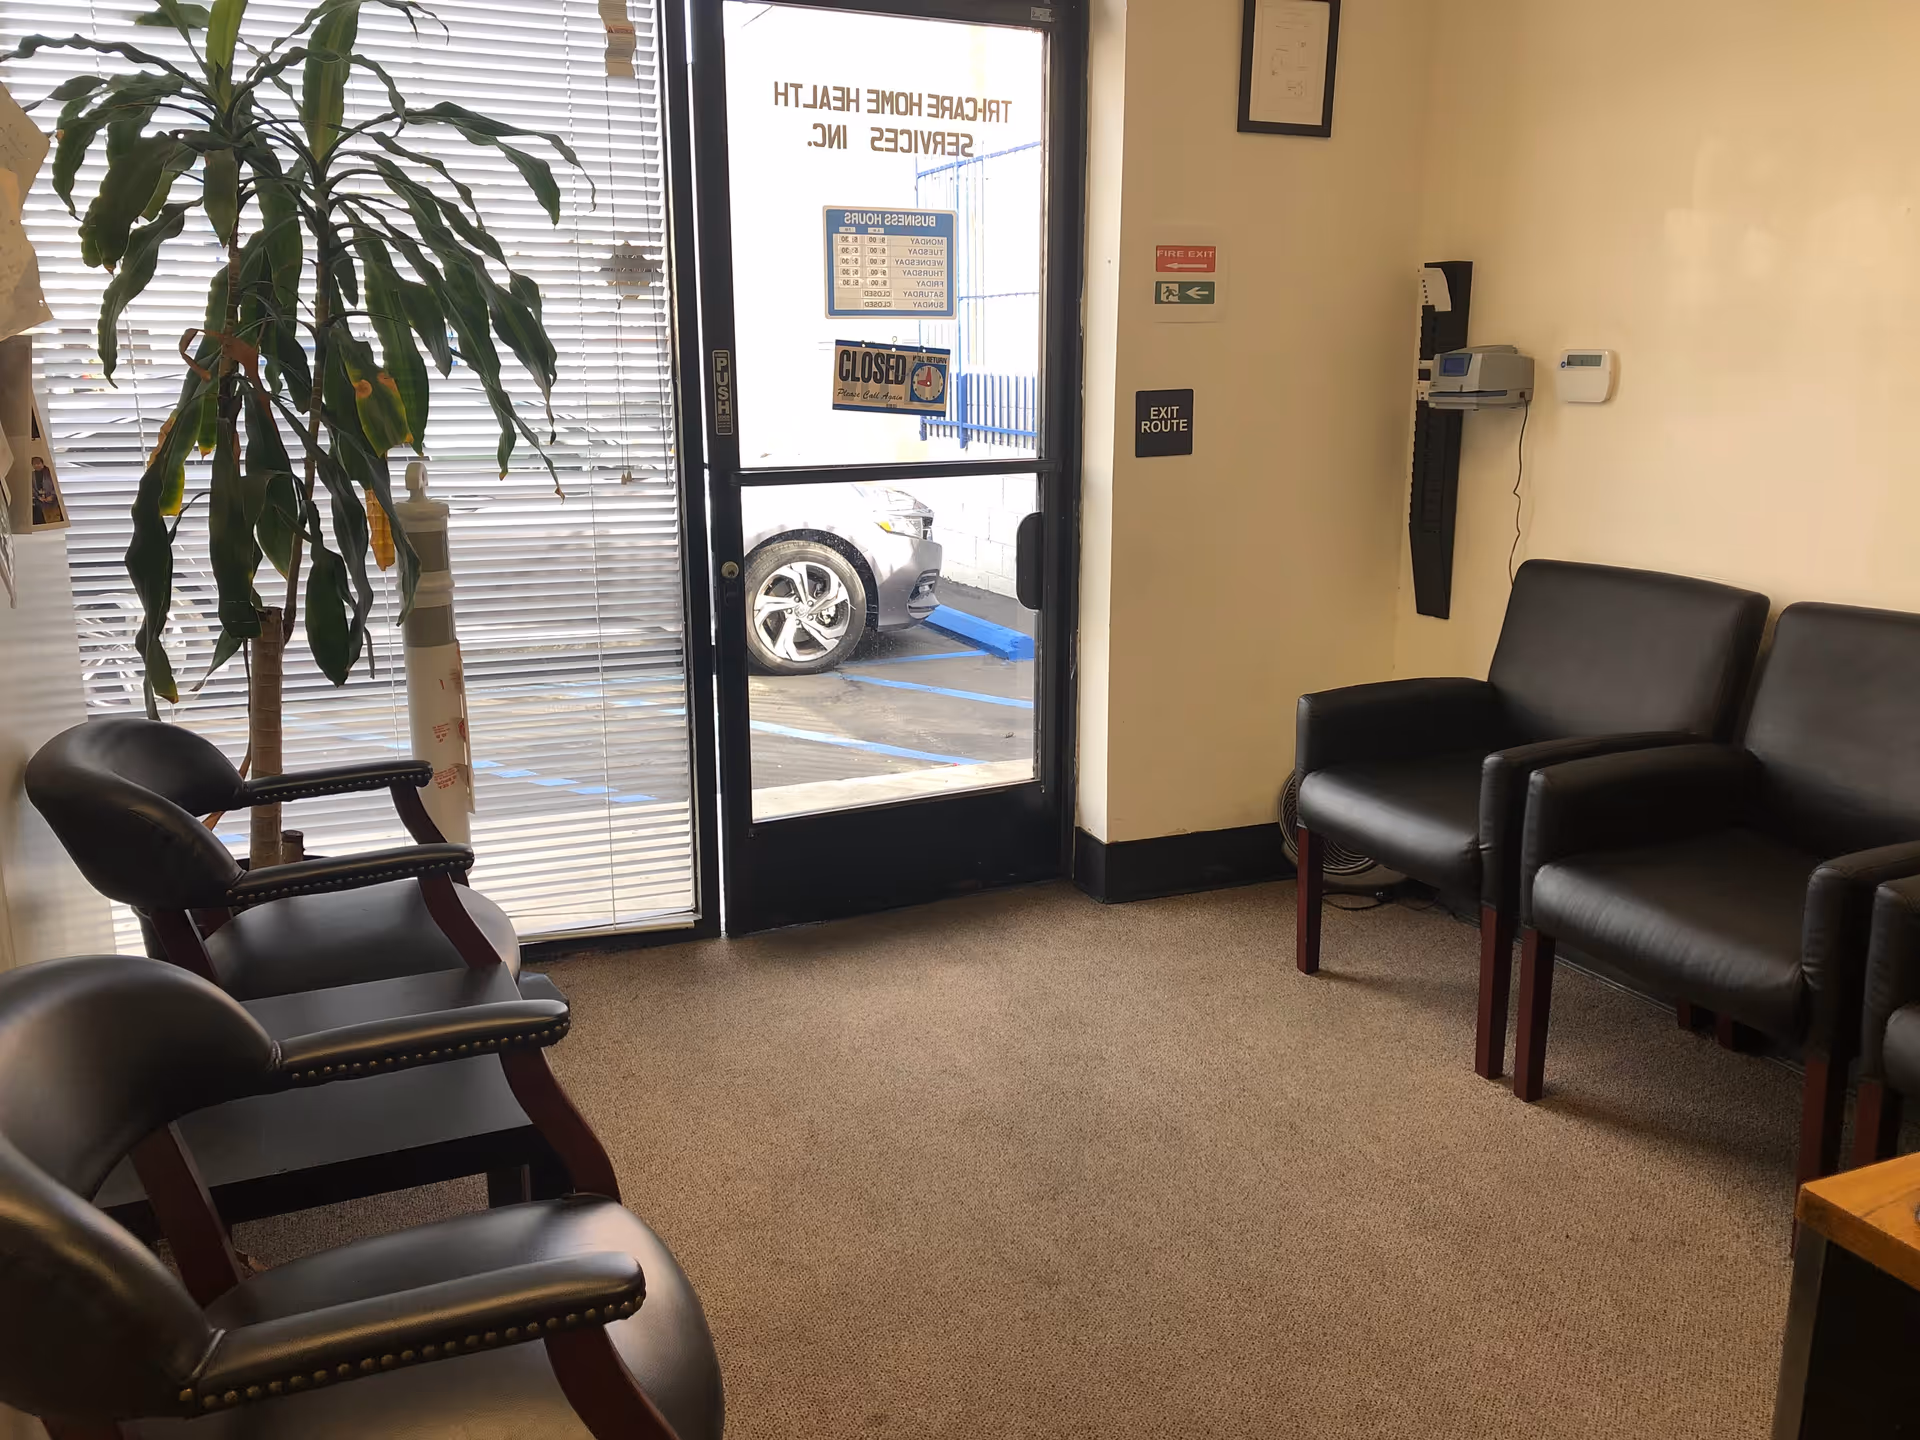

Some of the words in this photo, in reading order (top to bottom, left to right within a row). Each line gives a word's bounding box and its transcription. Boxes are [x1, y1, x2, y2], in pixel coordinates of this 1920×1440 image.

[1157, 250, 1184, 258] FIRE
[1188, 250, 1214, 258] EXIT
[838, 349, 906, 385] CLOSED
[926, 356, 947, 364] RETURN
[716, 358, 730, 414] PUSH
[837, 388, 860, 398] Please
[863, 390, 879, 399] Call
[881, 391, 903, 402] Again
[1150, 406, 1179, 419] EXIT
[1141, 419, 1188, 433] ROUTE
